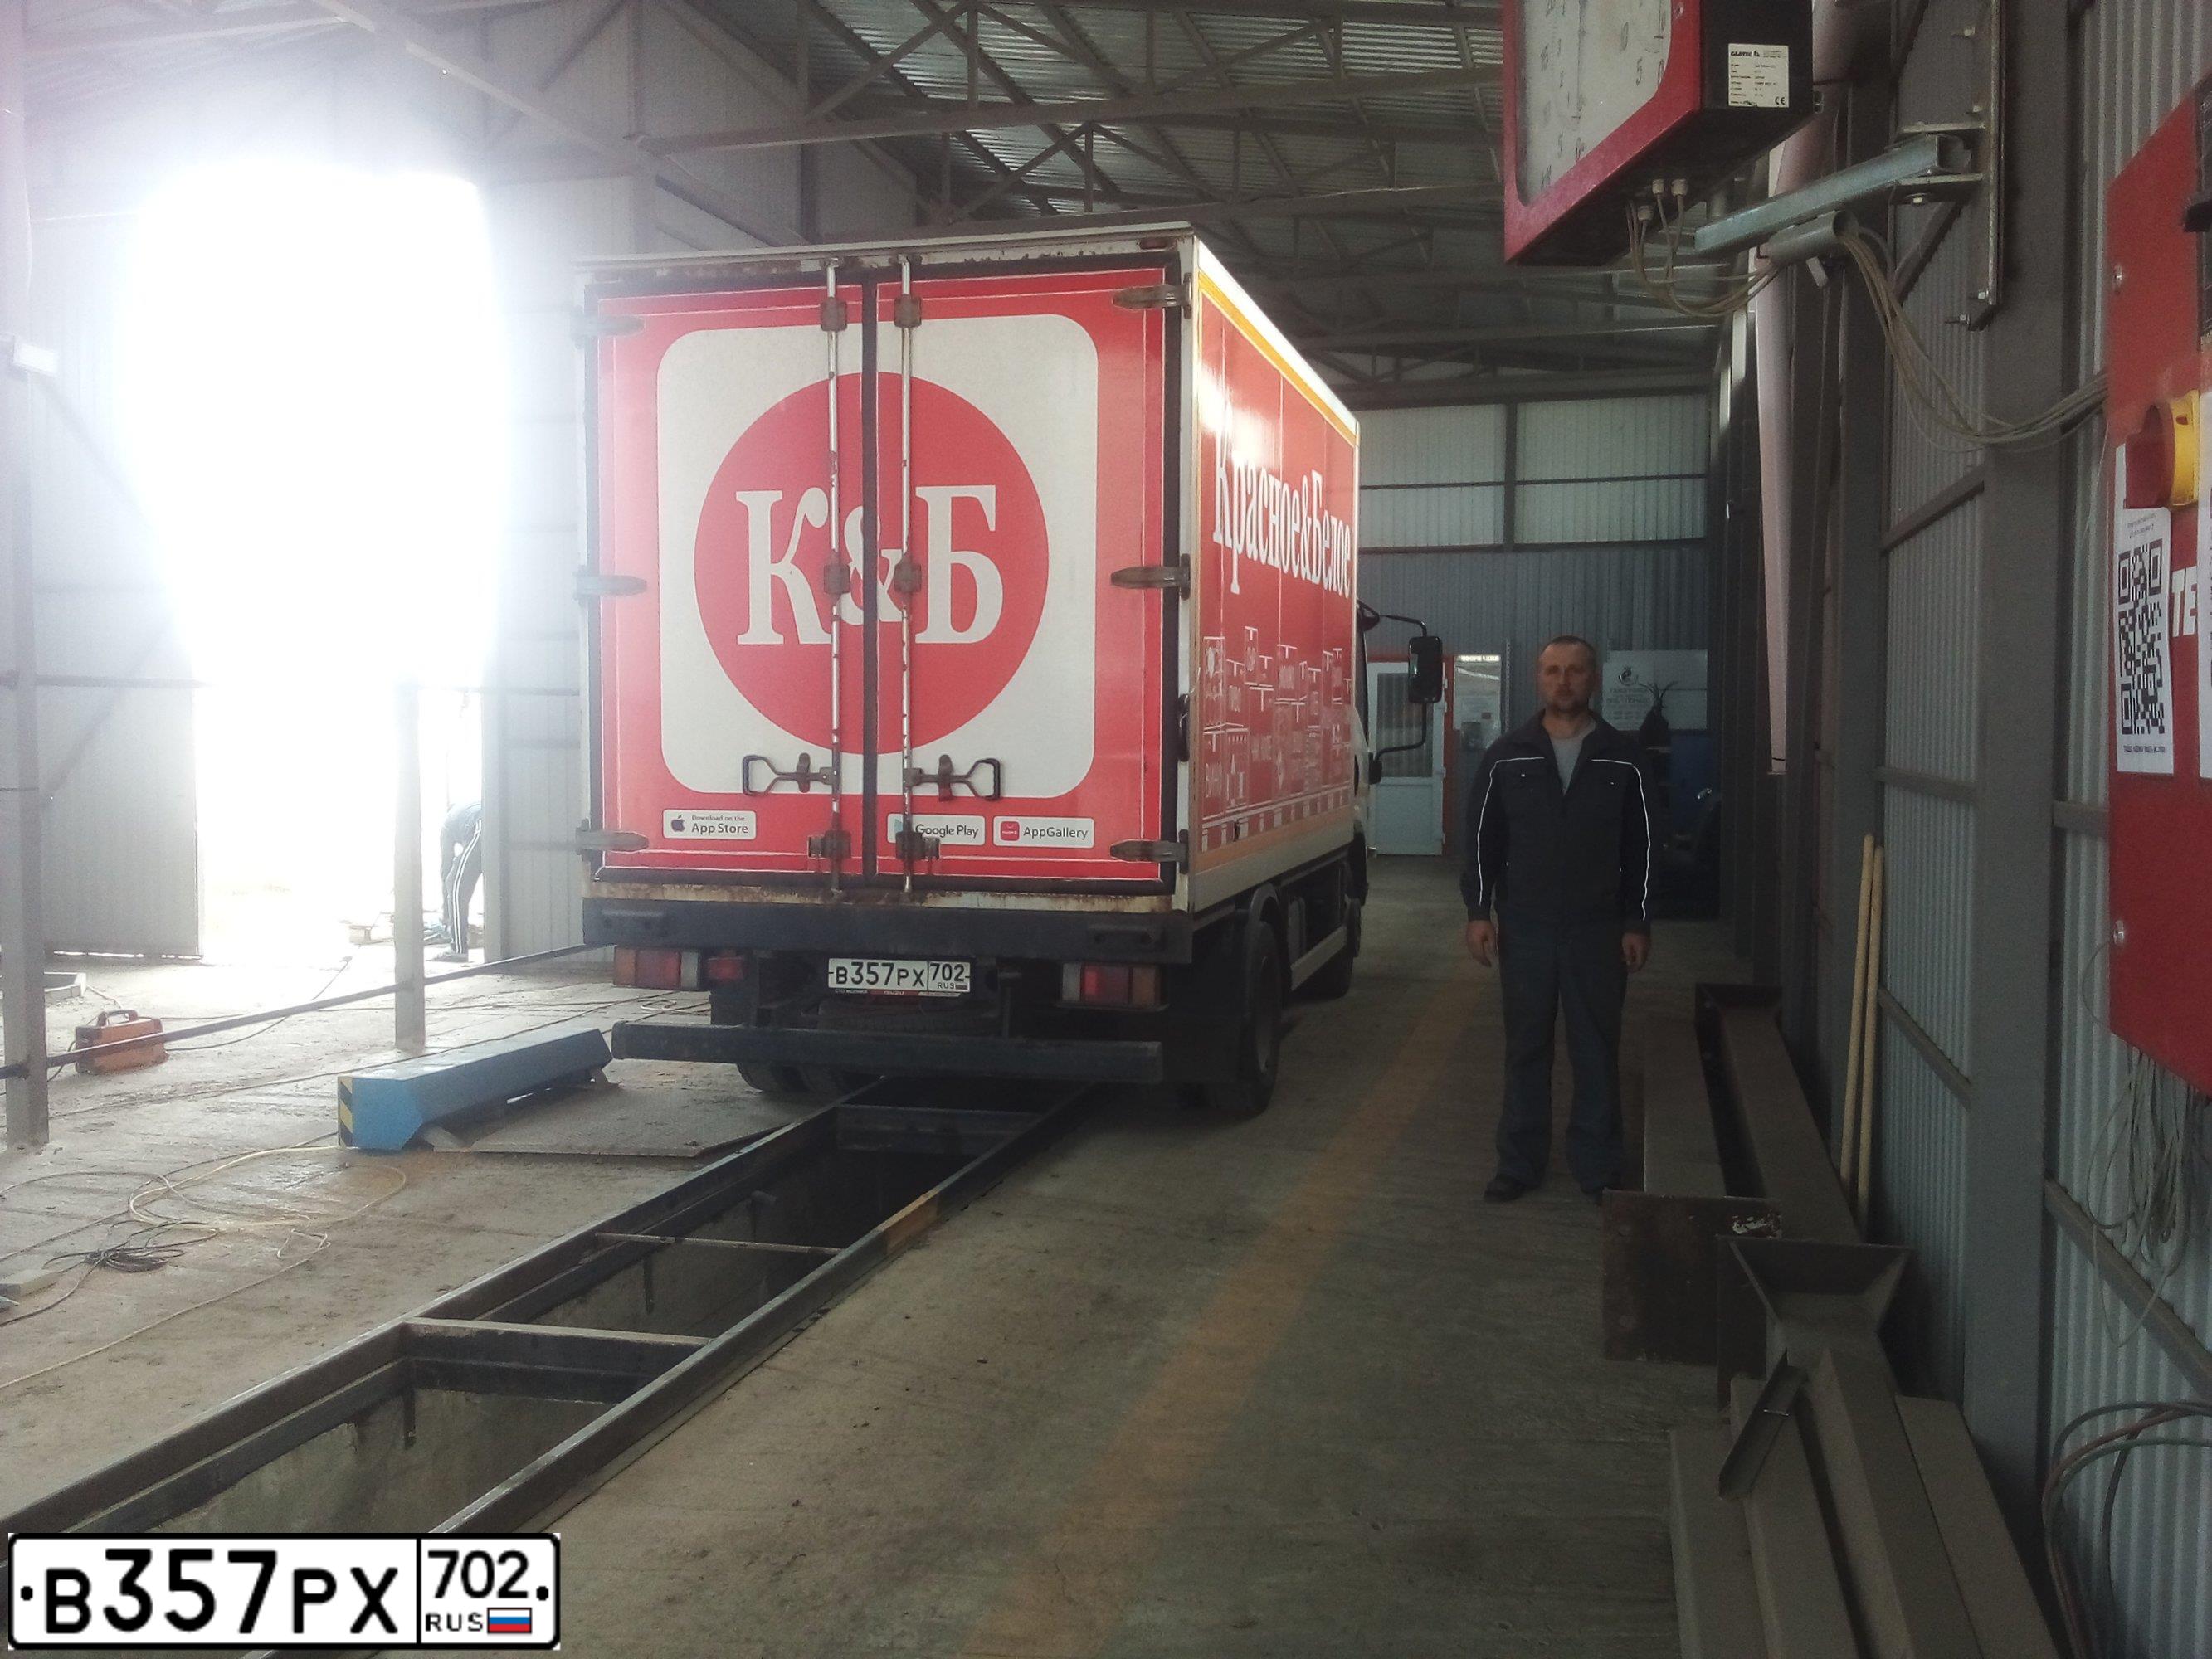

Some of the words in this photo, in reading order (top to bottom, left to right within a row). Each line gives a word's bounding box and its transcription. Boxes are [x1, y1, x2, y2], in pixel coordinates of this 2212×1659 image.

[691, 823, 715, 835] App
[718, 823, 748, 834] Store
[915, 824, 954, 838] Google
[957, 825, 979, 839] Play
[1023, 826, 1089, 840] AppGallery
[930, 962, 965, 982] 702
